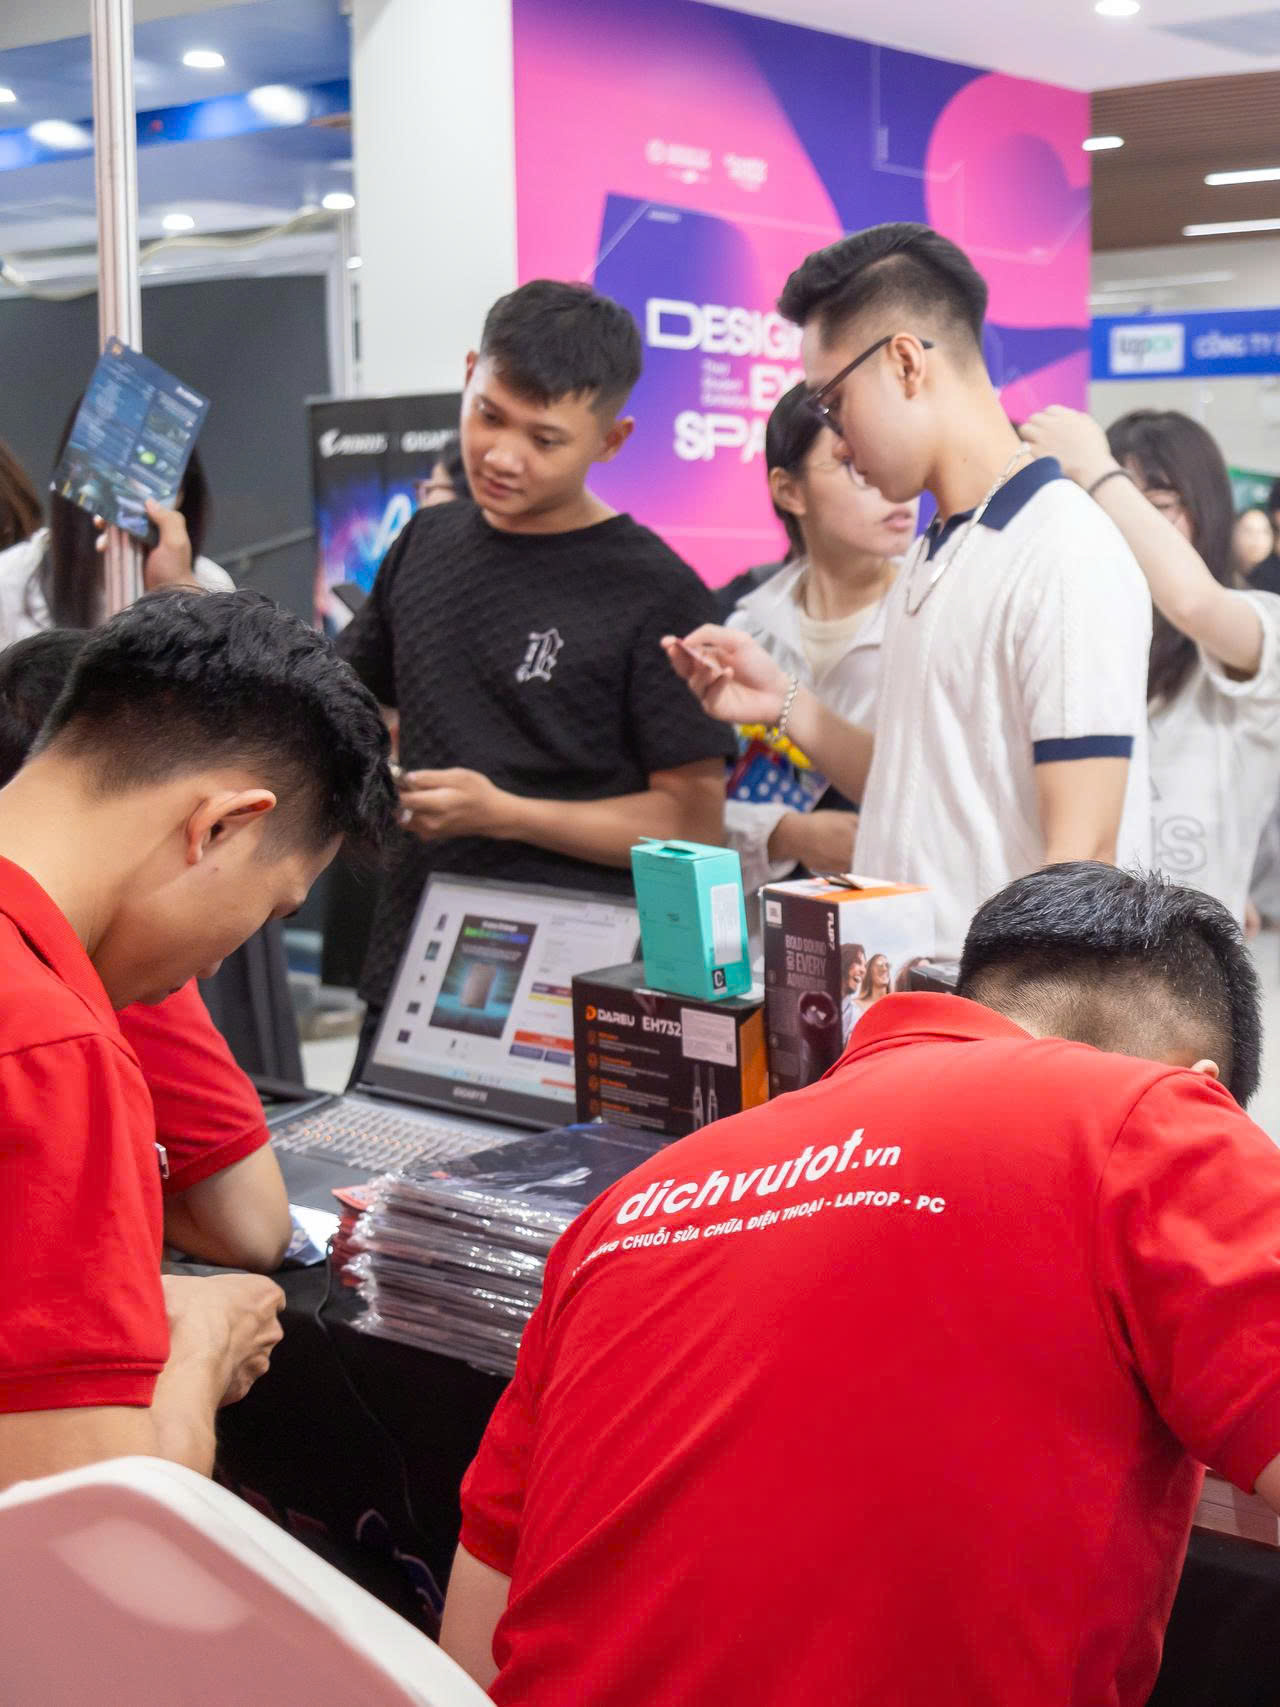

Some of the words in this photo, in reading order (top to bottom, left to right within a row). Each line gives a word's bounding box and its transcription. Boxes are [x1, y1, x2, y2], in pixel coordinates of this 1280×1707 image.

[598, 1008, 635, 1027] DAREU
[642, 1016, 682, 1036] EH732
[615, 1128, 901, 1225] dichvutot.vn
[622, 1226, 671, 1250] CHUỖI
[672, 1224, 699, 1244] SỬA
[703, 1218, 744, 1238] CHỮA
[747, 1211, 778, 1231] ĐIỆN
[781, 1197, 825, 1219] THOẠI
[834, 1191, 900, 1208] LAPTOP
[916, 1195, 946, 1214] PC
